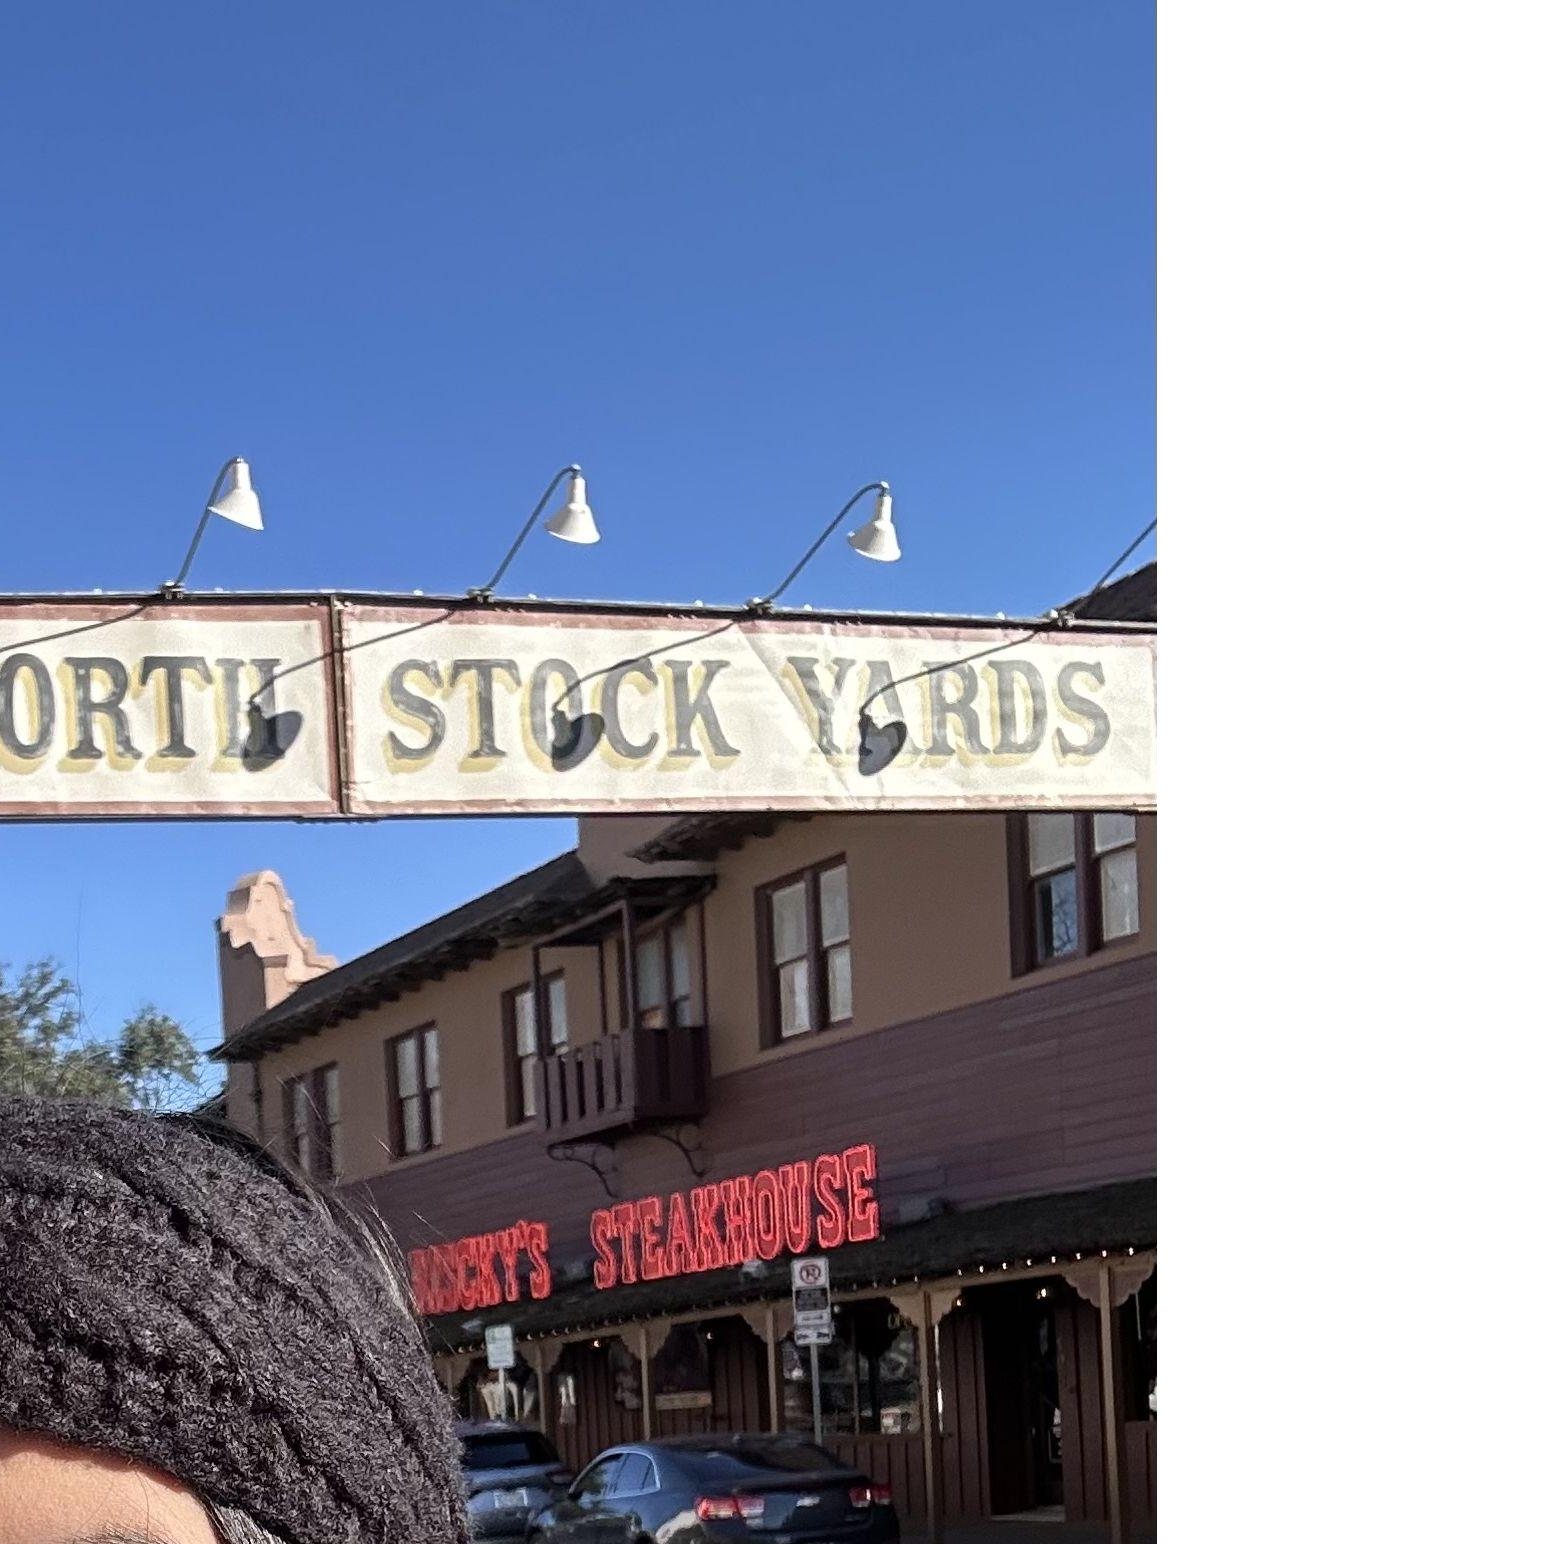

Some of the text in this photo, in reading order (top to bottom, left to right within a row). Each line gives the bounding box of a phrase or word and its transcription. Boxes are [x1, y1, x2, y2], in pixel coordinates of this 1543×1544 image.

[387, 657, 741, 765] STOCK
[784, 655, 1112, 763] YARDS
[590, 1143, 880, 1290] STEAKHOUSE
